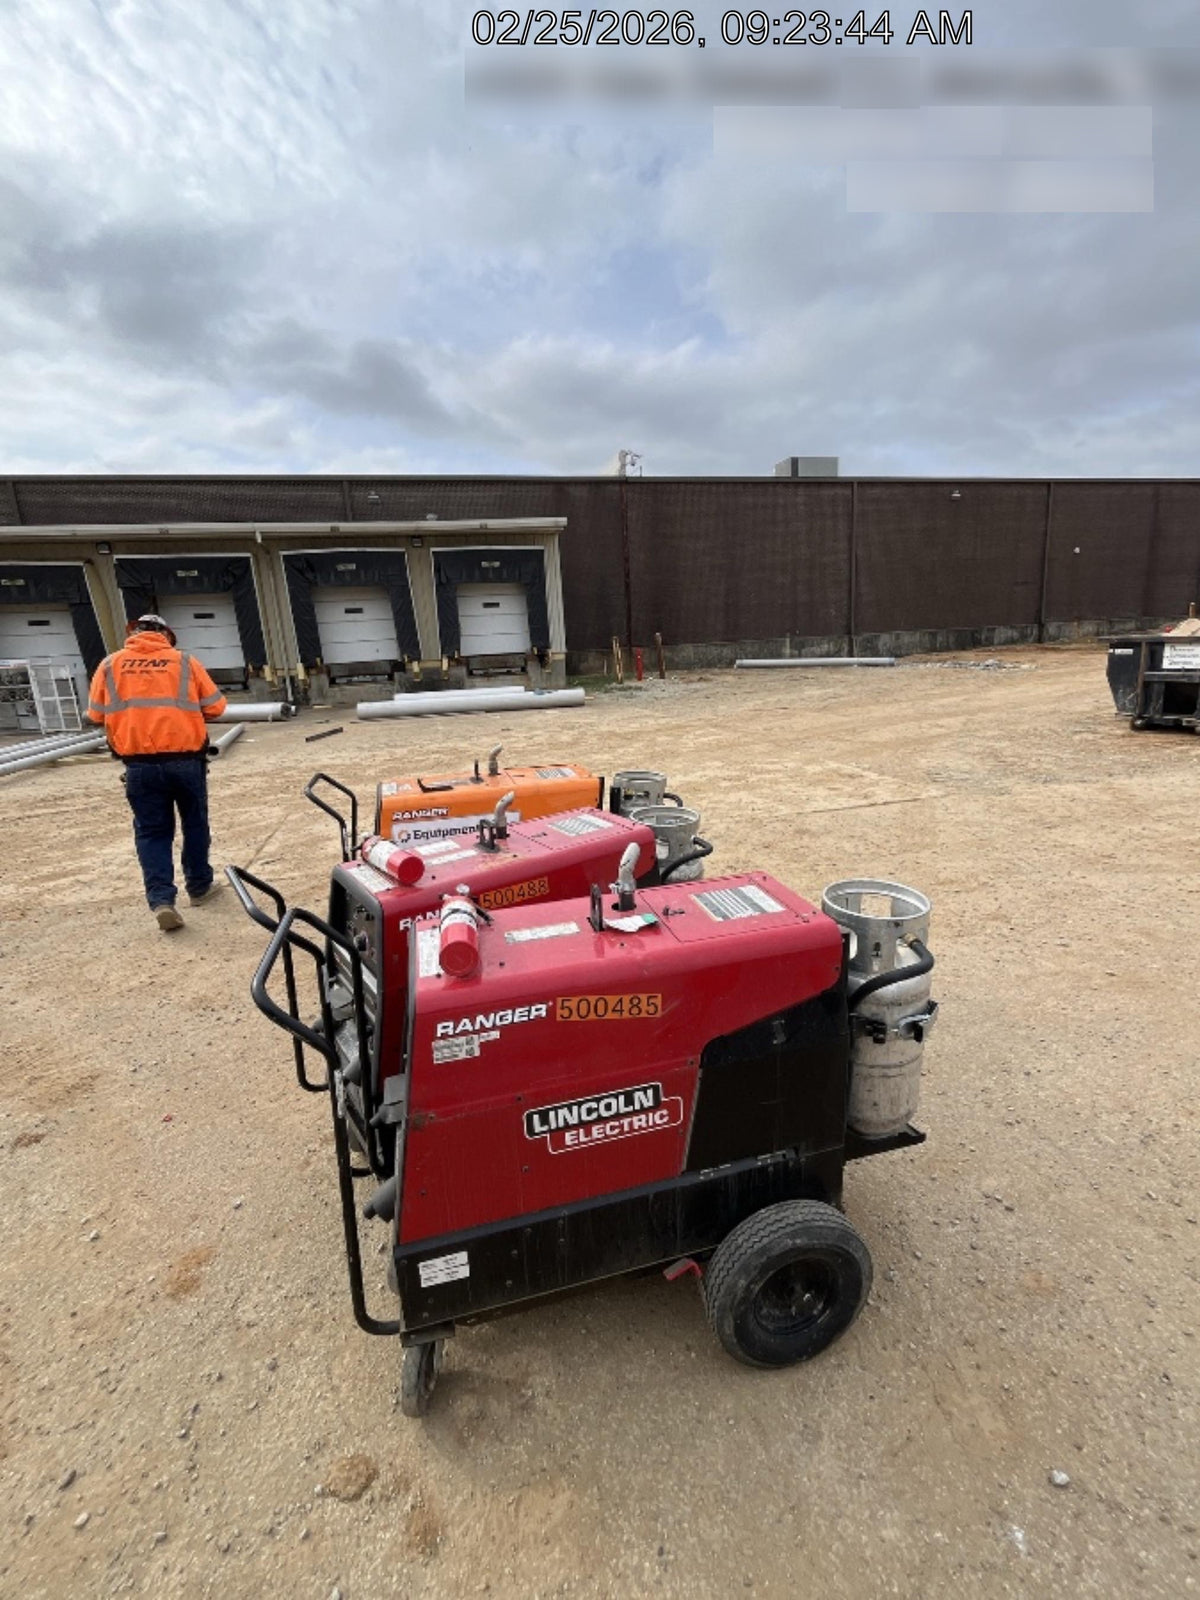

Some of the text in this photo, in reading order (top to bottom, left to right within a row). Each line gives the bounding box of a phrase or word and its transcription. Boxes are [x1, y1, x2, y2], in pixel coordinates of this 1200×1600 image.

[392, 807, 449, 821] RANGER
[481, 878, 549, 908] 500488
[399, 908, 440, 931] RAN
[436, 1003, 548, 1038] RANGER
[559, 994, 660, 1020] 500485
[532, 1088, 654, 1134] LINCOLN
[564, 1108, 670, 1146] ELECTRIC
